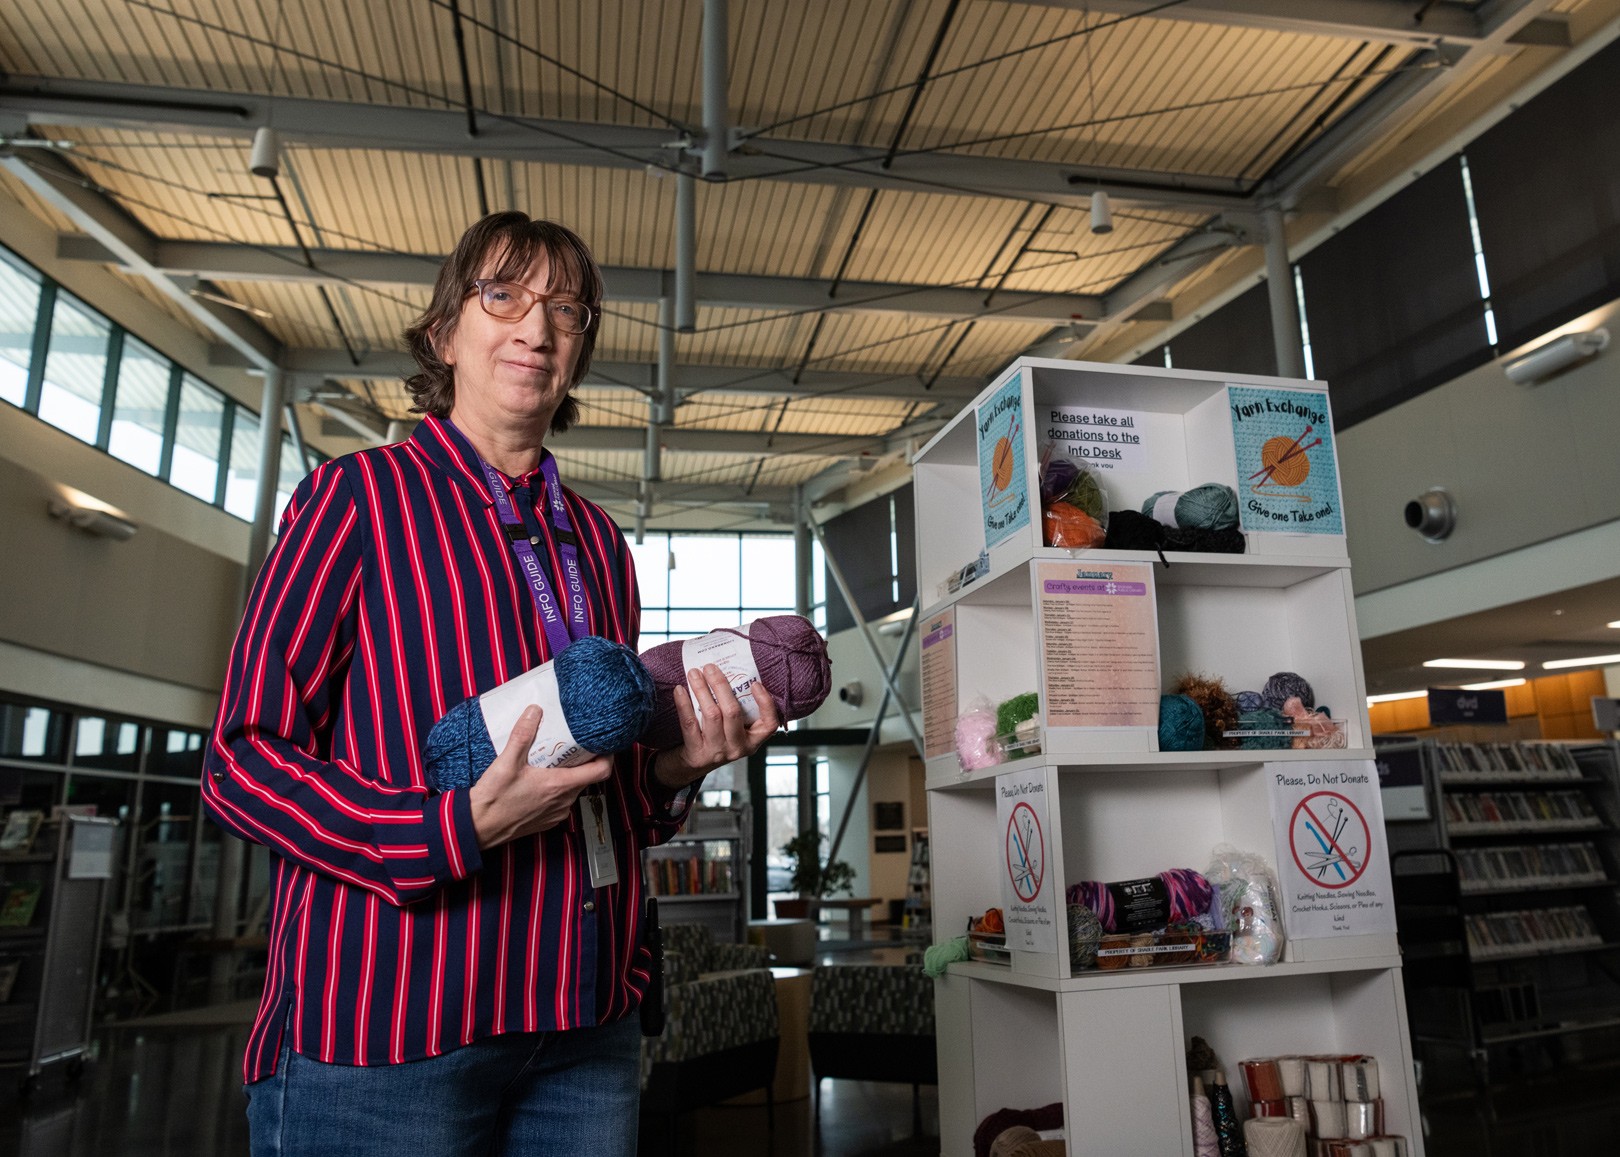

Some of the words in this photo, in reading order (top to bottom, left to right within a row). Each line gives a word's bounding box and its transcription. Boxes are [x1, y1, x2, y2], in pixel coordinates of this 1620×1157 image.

[1051, 411, 1090, 424] Please
[1093, 414, 1118, 426] take
[1121, 416, 1134, 428] all
[1231, 401, 1264, 421] Yarn
[1266, 398, 1326, 424] Exchange
[979, 412, 994, 440] Yarn
[1048, 428, 1104, 442] donations
[1107, 431, 1118, 442] to
[1122, 432, 1140, 444] the
[1068, 445, 1090, 458] Info
[1093, 447, 1122, 460] Desk
[489, 471, 508, 506] GUIDE
[1248, 499, 1269, 518] Give
[1272, 511, 1289, 522] one
[1290, 510, 1314, 523] Take
[1315, 502, 1334, 518] one!
[523, 554, 545, 591] GUIDE
[567, 558, 580, 592] GUIDE
[1047, 583, 1071, 593] Crafty
[1098, 584, 1106, 592] at
[539, 593, 557, 623] INFO
[573, 594, 584, 623] INFO
[1276, 774, 1306, 786] Please,
[1307, 774, 1320, 784] Do
[1323, 774, 1338, 784] Not
[1340, 772, 1369, 784] Donate
[1297, 893, 1315, 902] Knitting
[1337, 891, 1355, 900] Sewing
